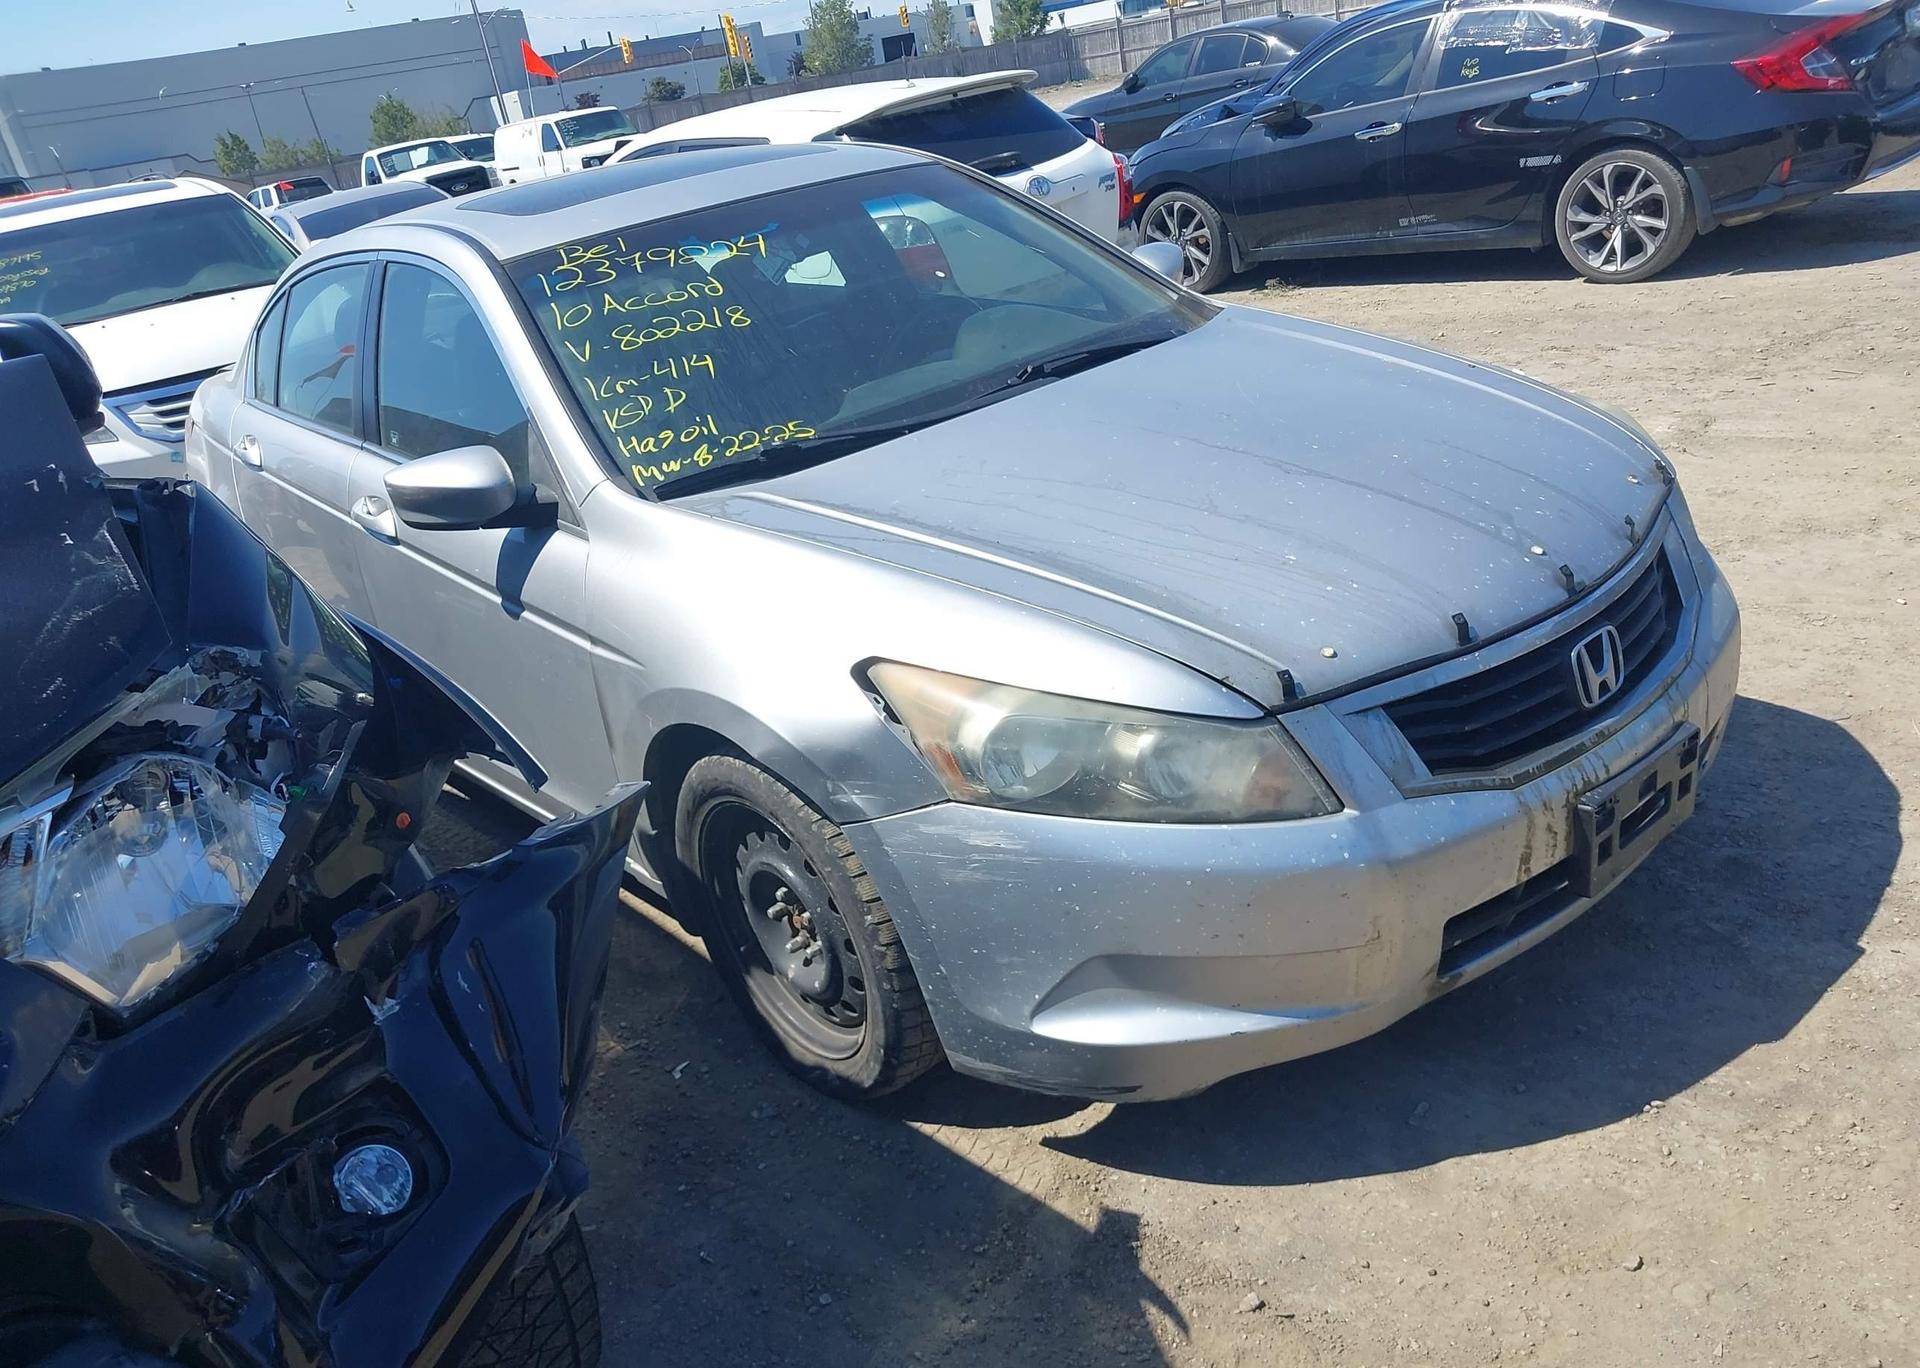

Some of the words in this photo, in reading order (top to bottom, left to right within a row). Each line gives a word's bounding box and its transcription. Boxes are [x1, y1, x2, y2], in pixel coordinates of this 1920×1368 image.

[536, 233, 767, 297] 12379824
[550, 302, 592, 331] 10
[603, 275, 724, 316] Accord
[680, 414, 719, 443] oil
